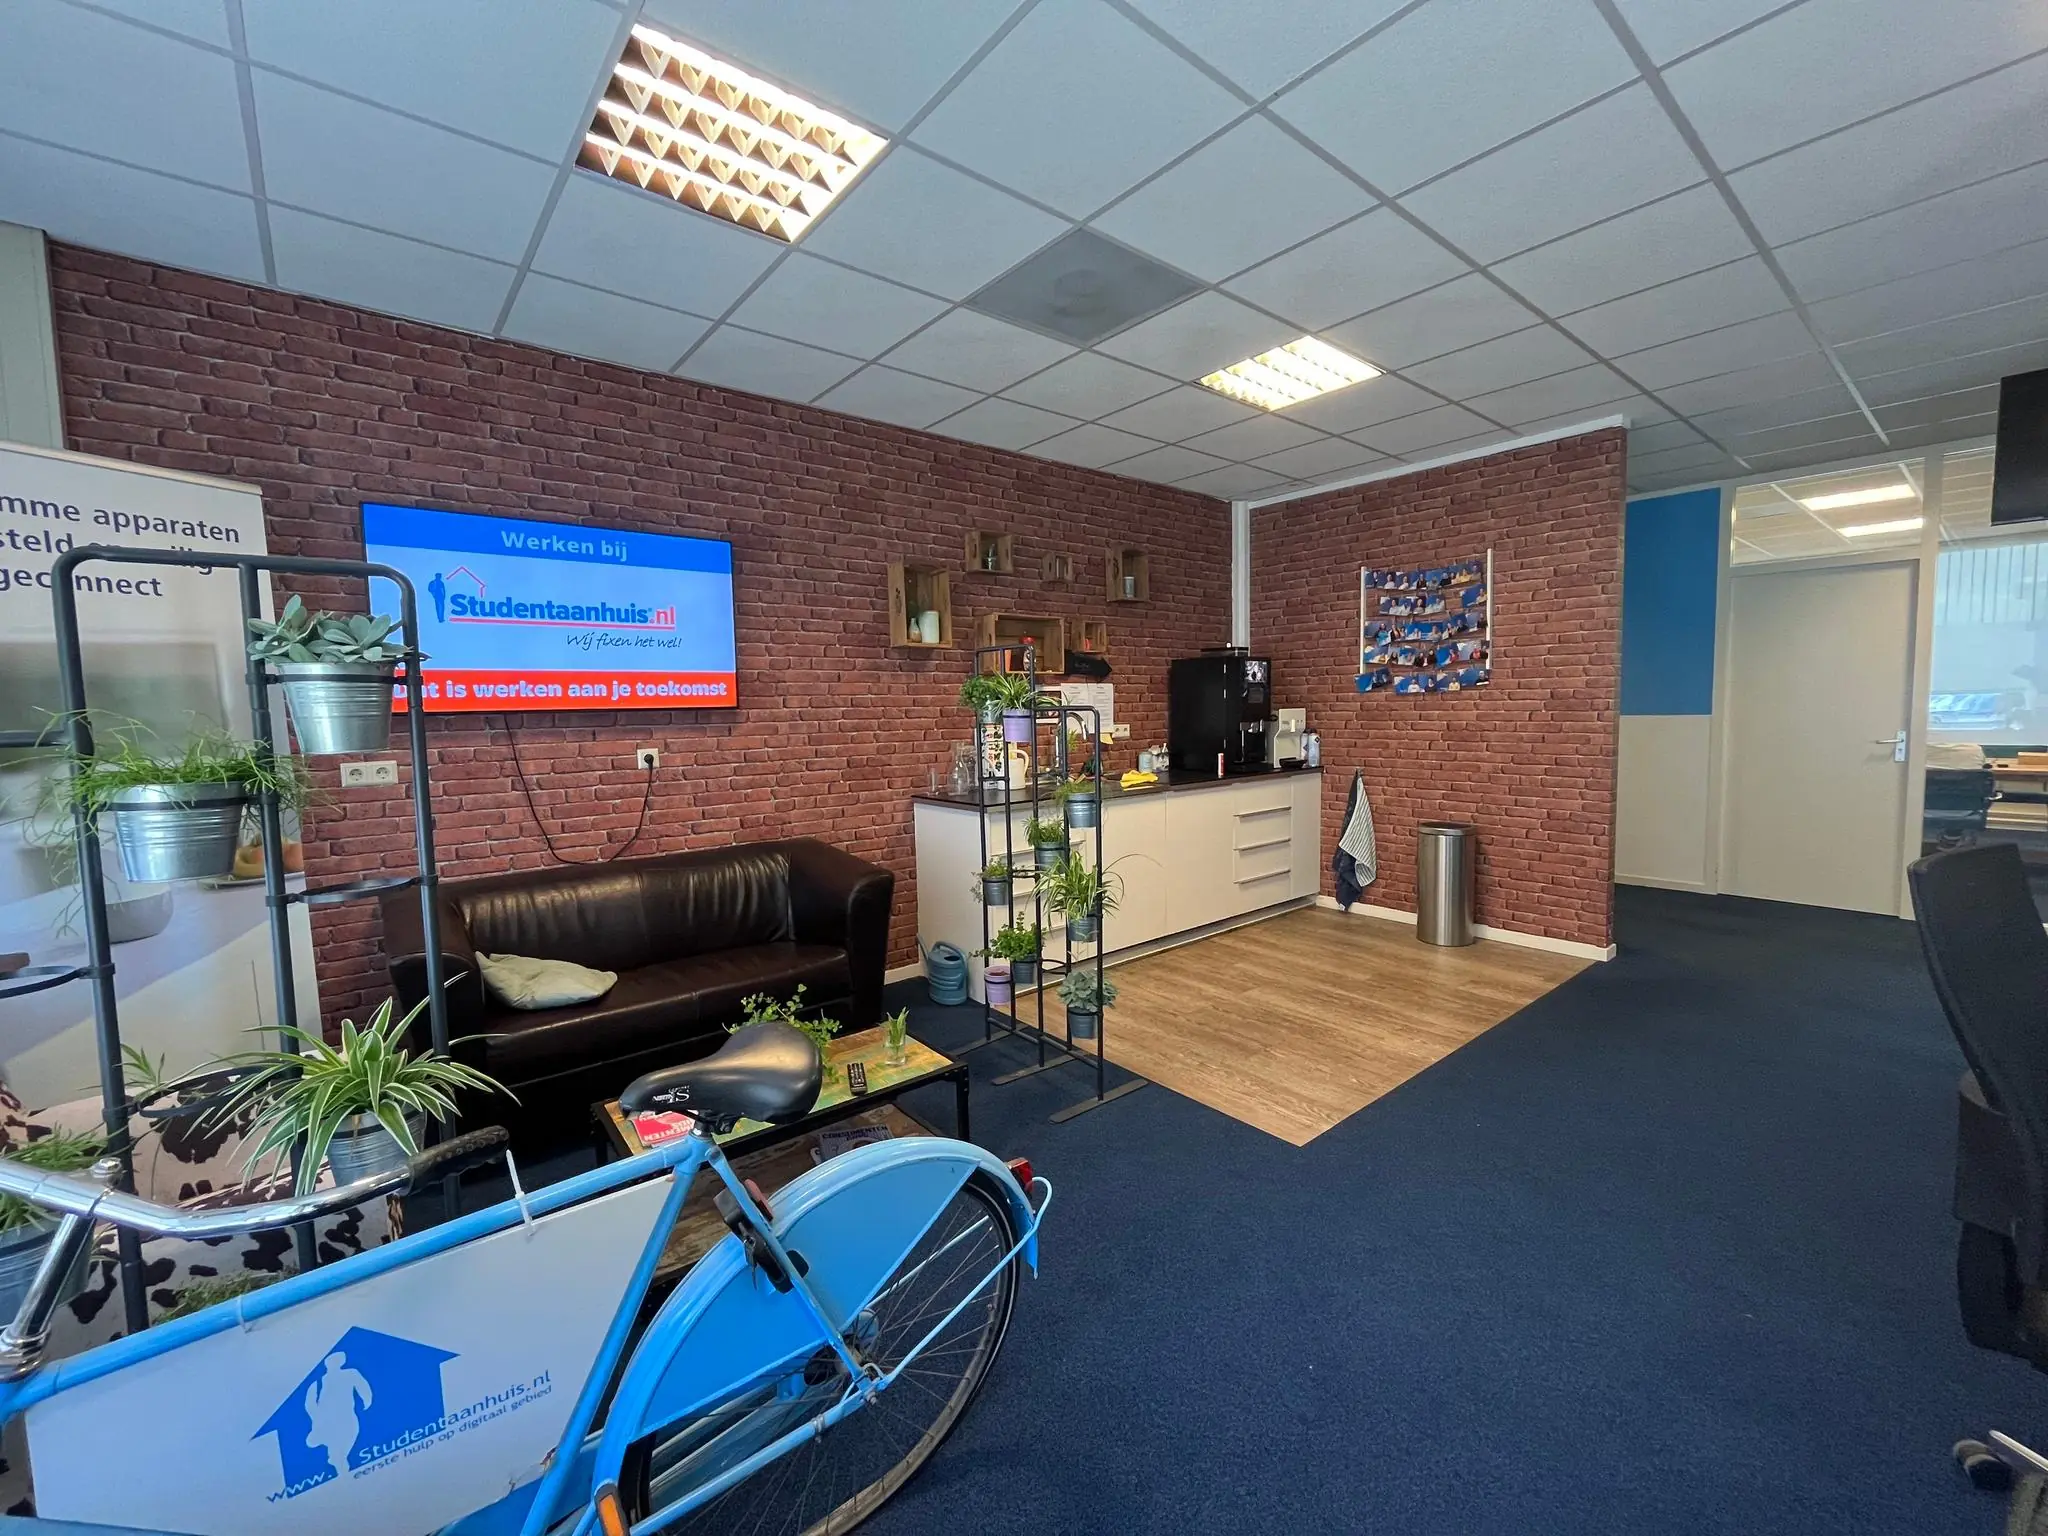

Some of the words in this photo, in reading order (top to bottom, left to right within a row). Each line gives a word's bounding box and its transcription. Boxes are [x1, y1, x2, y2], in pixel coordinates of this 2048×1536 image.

[93, 508, 240, 543] apparaten
[501, 530, 594, 555] Werken
[601, 540, 628, 562] bij
[0, 568, 163, 597] gecnnect
[567, 632, 595, 651] Wij
[596, 632, 632, 650] fixen
[633, 635, 654, 648] het
[657, 637, 682, 649] wel!
[446, 680, 467, 698] is
[472, 680, 562, 698] werken
[568, 684, 607, 697] aan
[611, 680, 631, 701] je
[636, 680, 727, 697] toekomst
[265, 1471, 332, 1503] www.
[358, 1369, 551, 1464] Studentaanhuis.nl
[353, 1454, 400, 1480] eerste
[403, 1439, 434, 1458] hulp
[438, 1430, 455, 1442] op
[459, 1405, 507, 1432] digitaal
[510, 1385, 552, 1411] gebied
